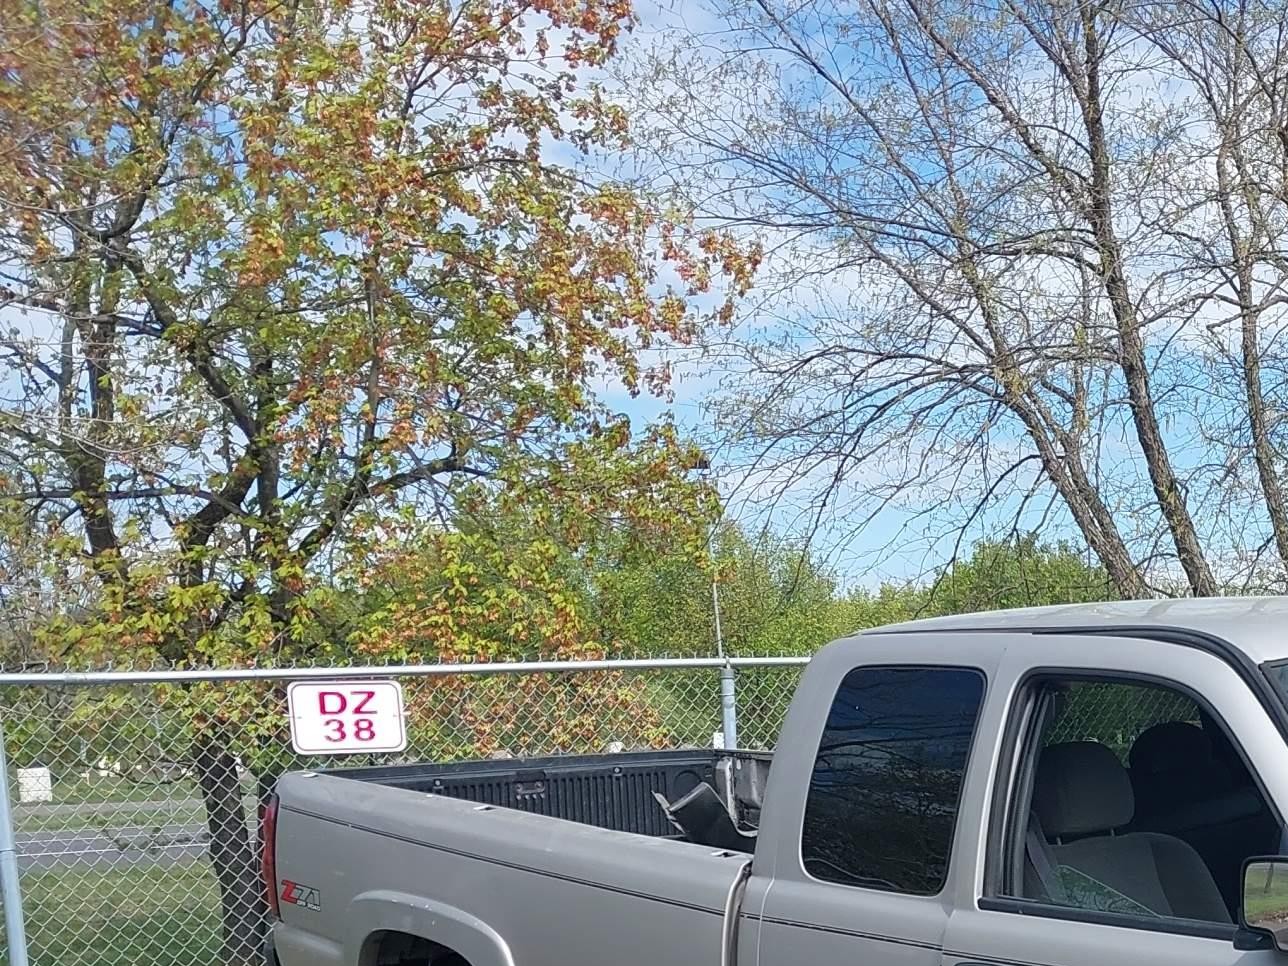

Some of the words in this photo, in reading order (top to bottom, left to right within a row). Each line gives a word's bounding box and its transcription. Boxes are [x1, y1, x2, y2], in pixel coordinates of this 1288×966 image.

[317, 690, 378, 716] DZ
[323, 718, 376, 743] 38
[280, 879, 321, 908] Z71
